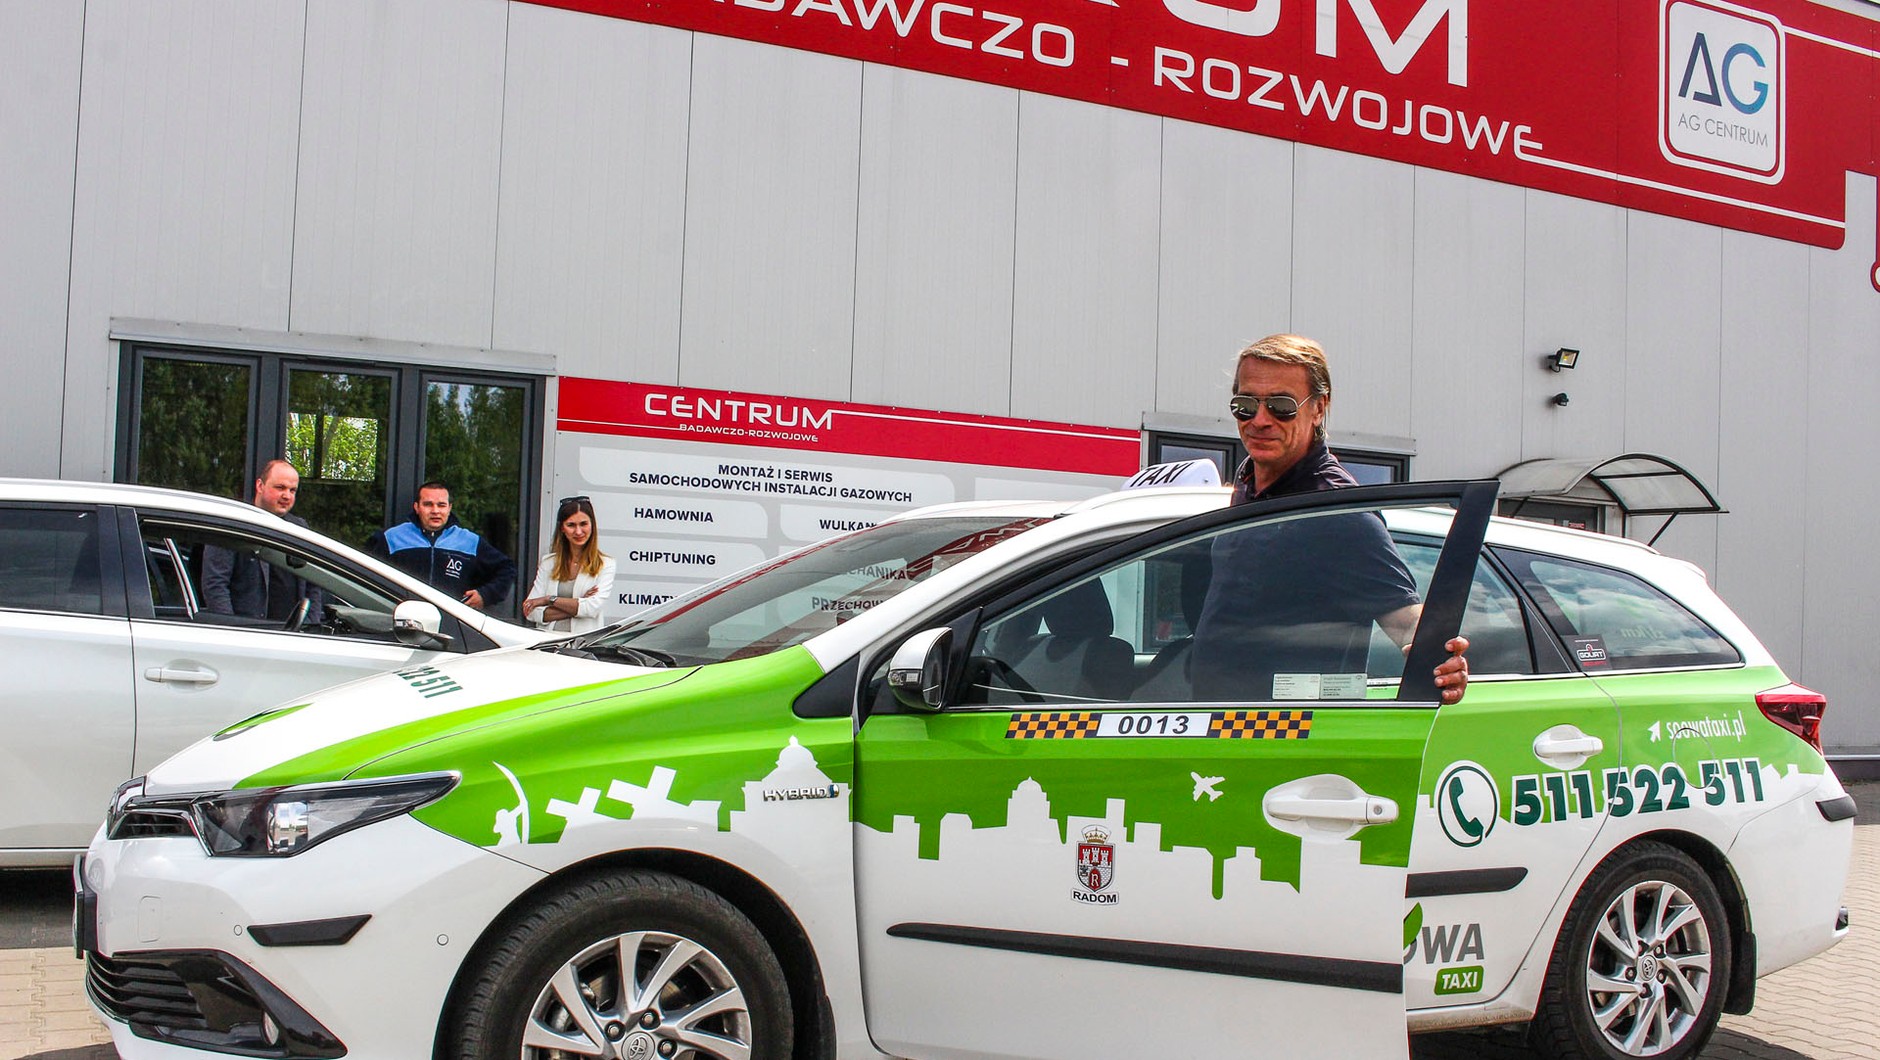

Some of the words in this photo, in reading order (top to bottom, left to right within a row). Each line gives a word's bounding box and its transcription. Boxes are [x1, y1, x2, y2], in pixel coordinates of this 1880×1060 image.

[1678, 32, 1769, 115] AG
[1153, 46, 1543, 162] ROZWOJOWE
[1678, 113, 1701, 132] AG
[1704, 118, 1769, 148] CENTRUM
[644, 393, 832, 430] CENTRUM
[679, 423, 819, 443] BADAWCZO-ROZWOJOWE
[718, 464, 774, 480] MONTAŻ
[777, 469, 782, 479] I
[784, 469, 833, 483] SERWIS
[1129, 461, 1195, 488] TAXI
[629, 472, 761, 493] SAMOCHODOWYCH
[764, 481, 837, 498] INSTALACJI
[840, 487, 912, 503] GAZOWYCH
[634, 507, 714, 523] HAMOWNIA
[629, 550, 717, 566] CHIPTUNING
[618, 593, 675, 606] KLIMAT
[410, 675, 463, 698] 511
[1117, 715, 1190, 735] 0013
[1665, 709, 1747, 742] soowataxi.pl
[763, 787, 828, 802] HYBRID
[1513, 773, 1594, 826] 511
[1606, 765, 1690, 817] 522
[1701, 760, 1765, 807] 511
[1073, 891, 1117, 903] RADOM
[1404, 923, 1485, 965] WA
[1441, 971, 1479, 990] TAXI
